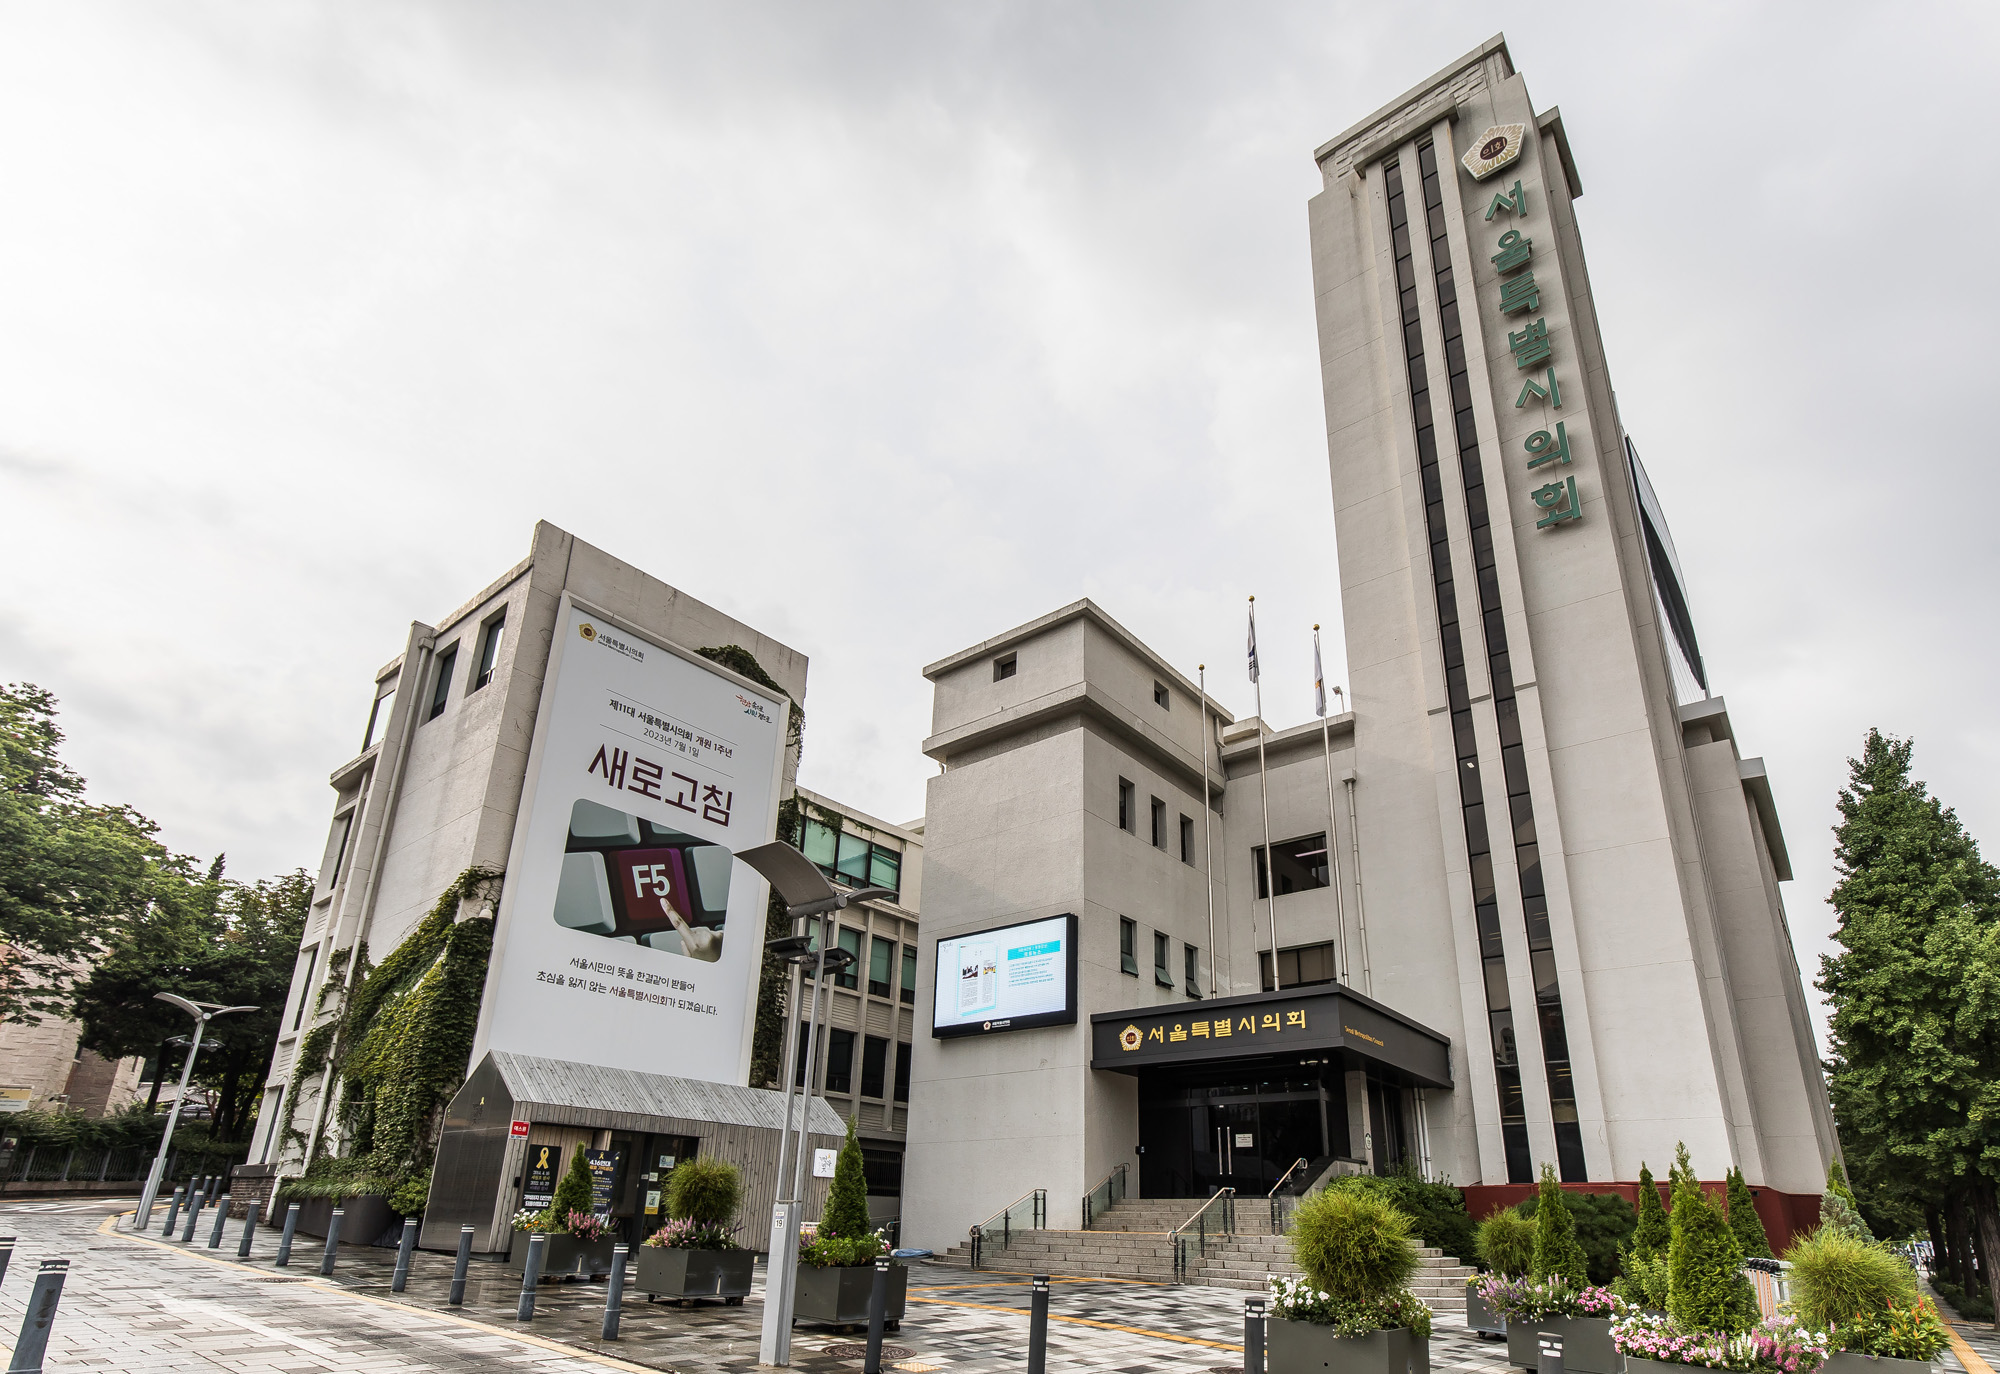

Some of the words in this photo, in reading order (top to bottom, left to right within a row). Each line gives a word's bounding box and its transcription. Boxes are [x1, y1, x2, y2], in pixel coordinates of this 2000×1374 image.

[1481, 138, 1506, 159] 의회
[1485, 180, 1583, 530] 서울특별시의회
[598, 633, 645, 660] 서울특별시의회
[609, 699, 636, 718] 제11대
[637, 711, 693, 742] 서울특별시의회
[695, 735, 712, 750] 개원
[713, 743, 733, 758] 1주년
[643, 727, 672, 746] 2023년
[674, 740, 687, 752] 7월
[688, 746, 700, 758] 1일
[587, 743, 733, 827] 새로고침
[632, 864, 671, 898] F5
[569, 957, 615, 976] 서울시민의
[617, 966, 634, 980] 뜻을
[636, 971, 670, 987] 한결같이
[671, 979, 695, 993] 받들어
[536, 970, 565, 986] 초심을
[568, 976, 587, 990] 잃지
[588, 980, 607, 994] 않는
[609, 985, 676, 1008] 서울특별시의회가
[677, 999, 718, 1016] 되겠습니다.
[1148, 1009, 1306, 1044] 서울특별시의회
[776, 1219, 783, 1228] 19
